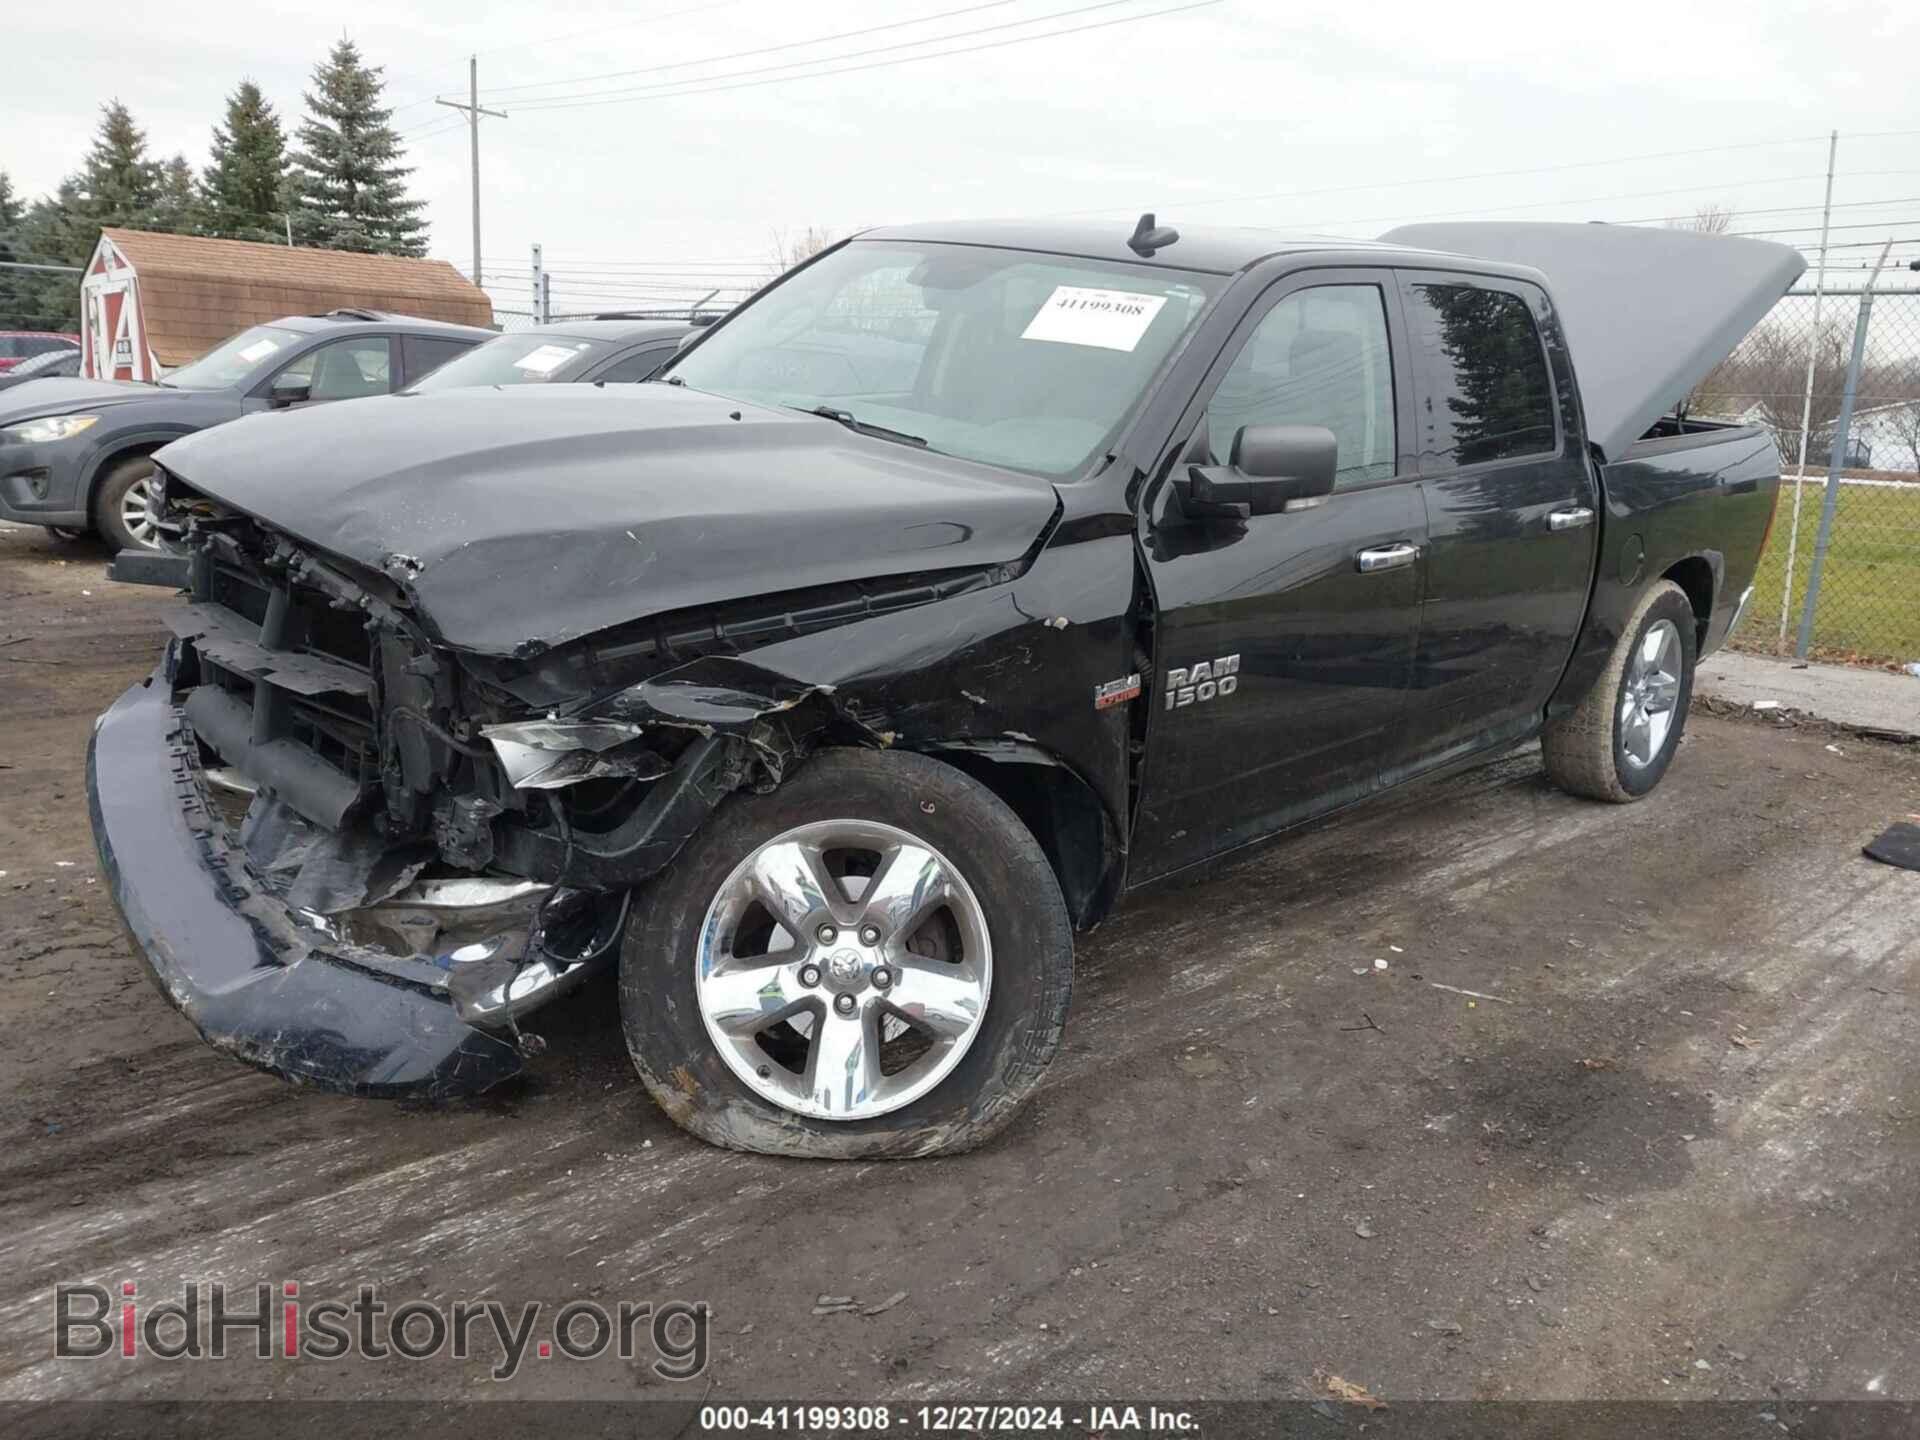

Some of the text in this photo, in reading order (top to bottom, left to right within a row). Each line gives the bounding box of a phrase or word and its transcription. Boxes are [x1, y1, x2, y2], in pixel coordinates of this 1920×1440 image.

[1057, 298, 1145, 316] 41199308
[1166, 653, 1240, 690] RAM
[1165, 675, 1237, 711] 1500
